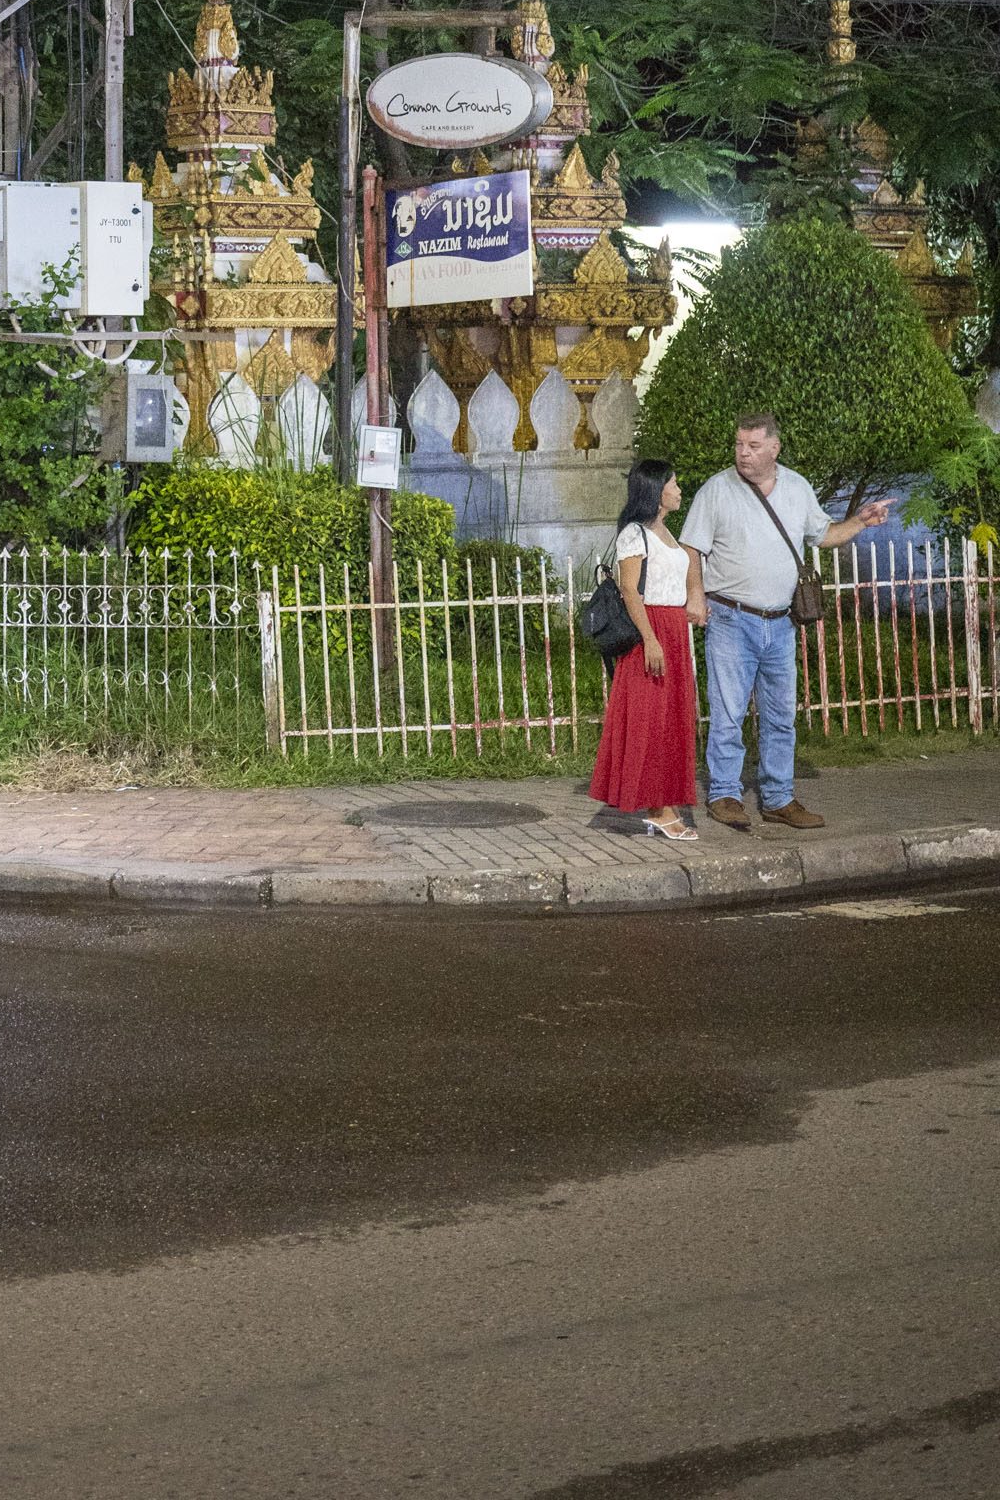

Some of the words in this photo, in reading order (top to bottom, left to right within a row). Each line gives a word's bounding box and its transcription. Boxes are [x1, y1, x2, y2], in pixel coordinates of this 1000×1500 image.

[386, 93, 441, 117] Common
[445, 88, 512, 116] Grounds
[418, 236, 462, 255] NAZIM
[467, 231, 509, 251] Restaurant
[439, 261, 472, 279] FOOD
